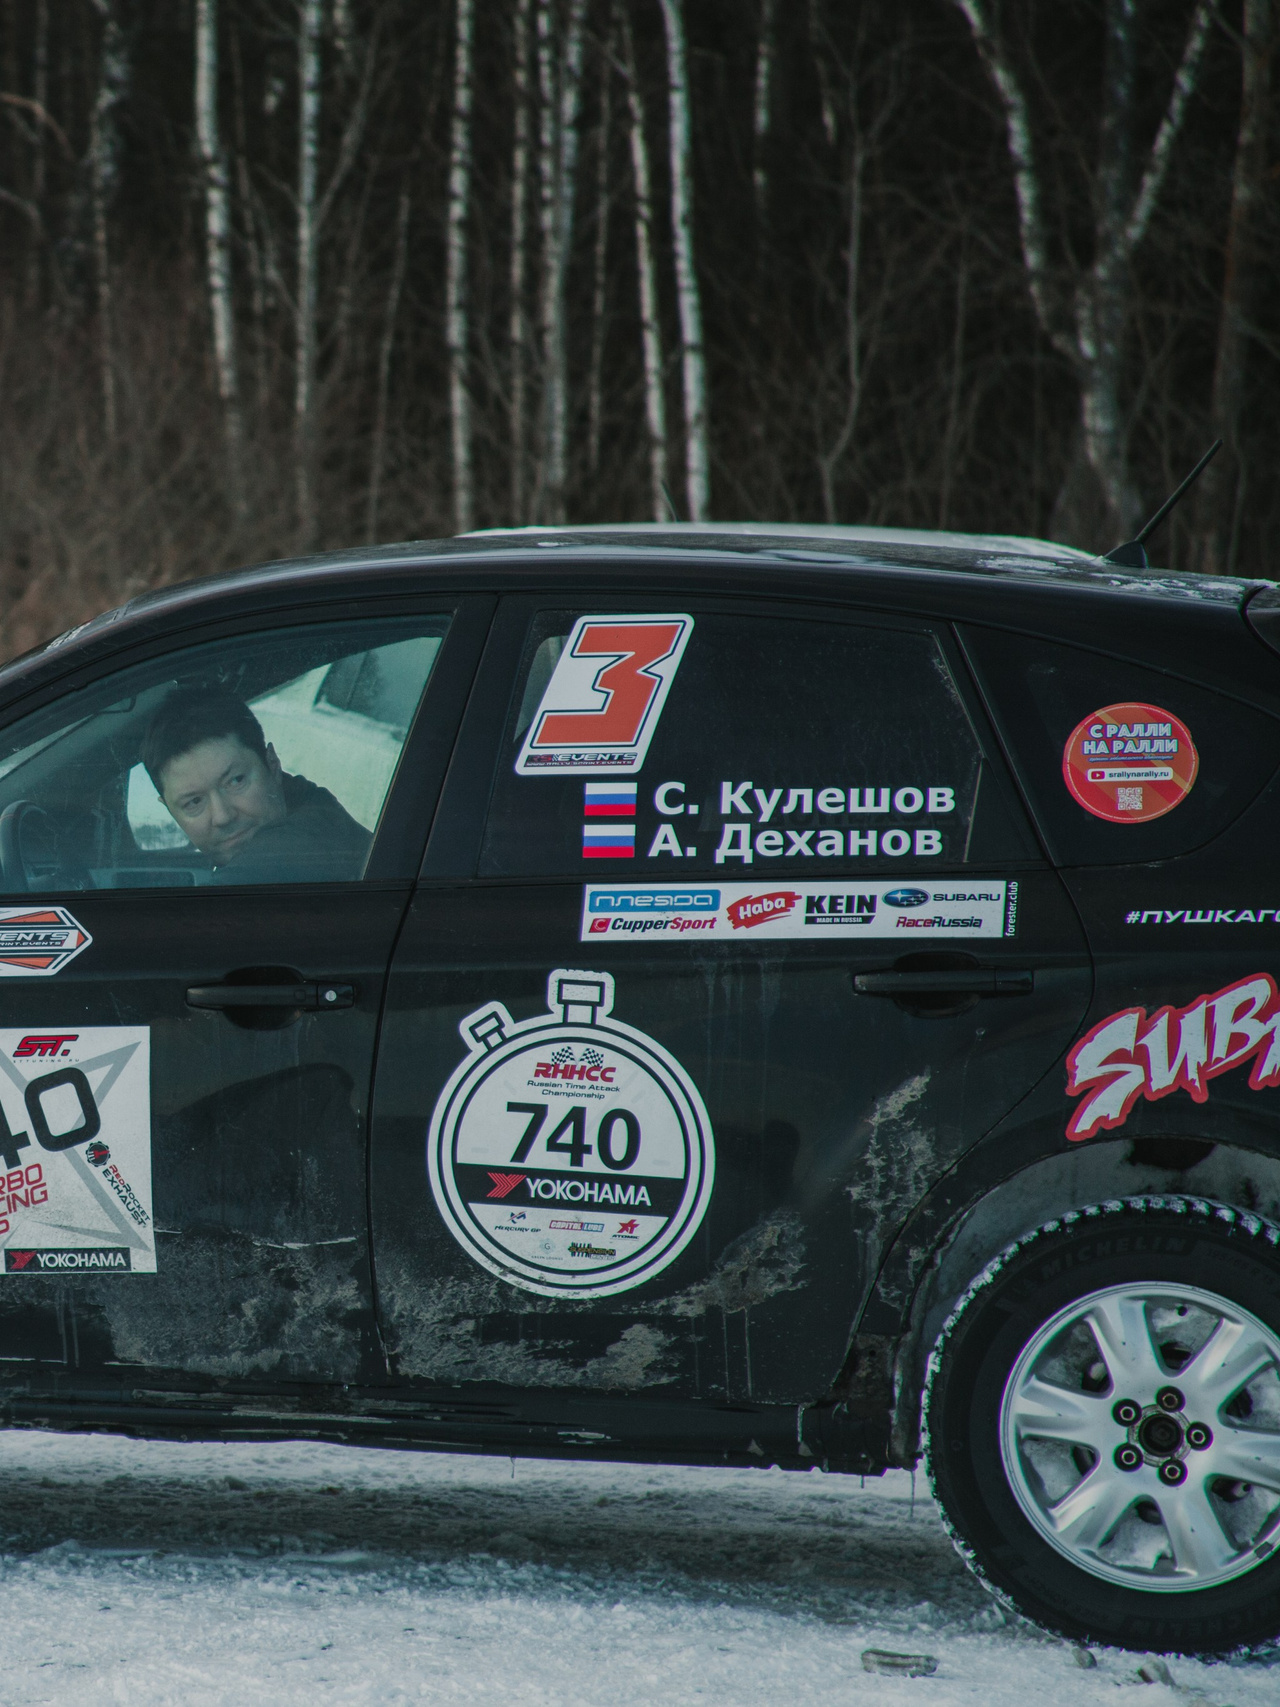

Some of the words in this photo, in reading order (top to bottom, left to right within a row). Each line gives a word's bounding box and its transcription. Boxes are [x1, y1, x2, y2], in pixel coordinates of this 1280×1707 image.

[531, 621, 685, 748] 3
[1106, 723, 1172, 738] РАЛЛИ
[1083, 740, 1109, 754] НА
[1112, 739, 1178, 753] РАЛЛИ
[1108, 771, 1169, 779] srallynarally.ru
[654, 781, 699, 815] С.
[721, 781, 956, 823] Кулешов
[648, 823, 697, 857] А.
[715, 823, 943, 864] Деханов
[805, 894, 877, 914] KEIN
[933, 893, 1001, 902] SUBARU
[738, 897, 786, 920] Haba
[1005, 881, 1019, 937] forester.club
[612, 917, 717, 932] CupperSport
[896, 916, 983, 928] RaceRussia
[1072, 978, 1280, 1134] SUB
[534, 1062, 616, 1083] RHHCC
[527, 1080, 562, 1088] Russian
[565, 1082, 586, 1090] Time
[588, 1084, 621, 1092] Attack
[541, 1089, 605, 1100] Championship
[506, 1101, 642, 1171] 740
[102, 1168, 147, 1226] EXHAUST
[526, 1176, 651, 1206] YOKOHAMA
[550, 1221, 582, 1230] CAPITAL
[36, 1252, 127, 1268] YOKOHAMA
